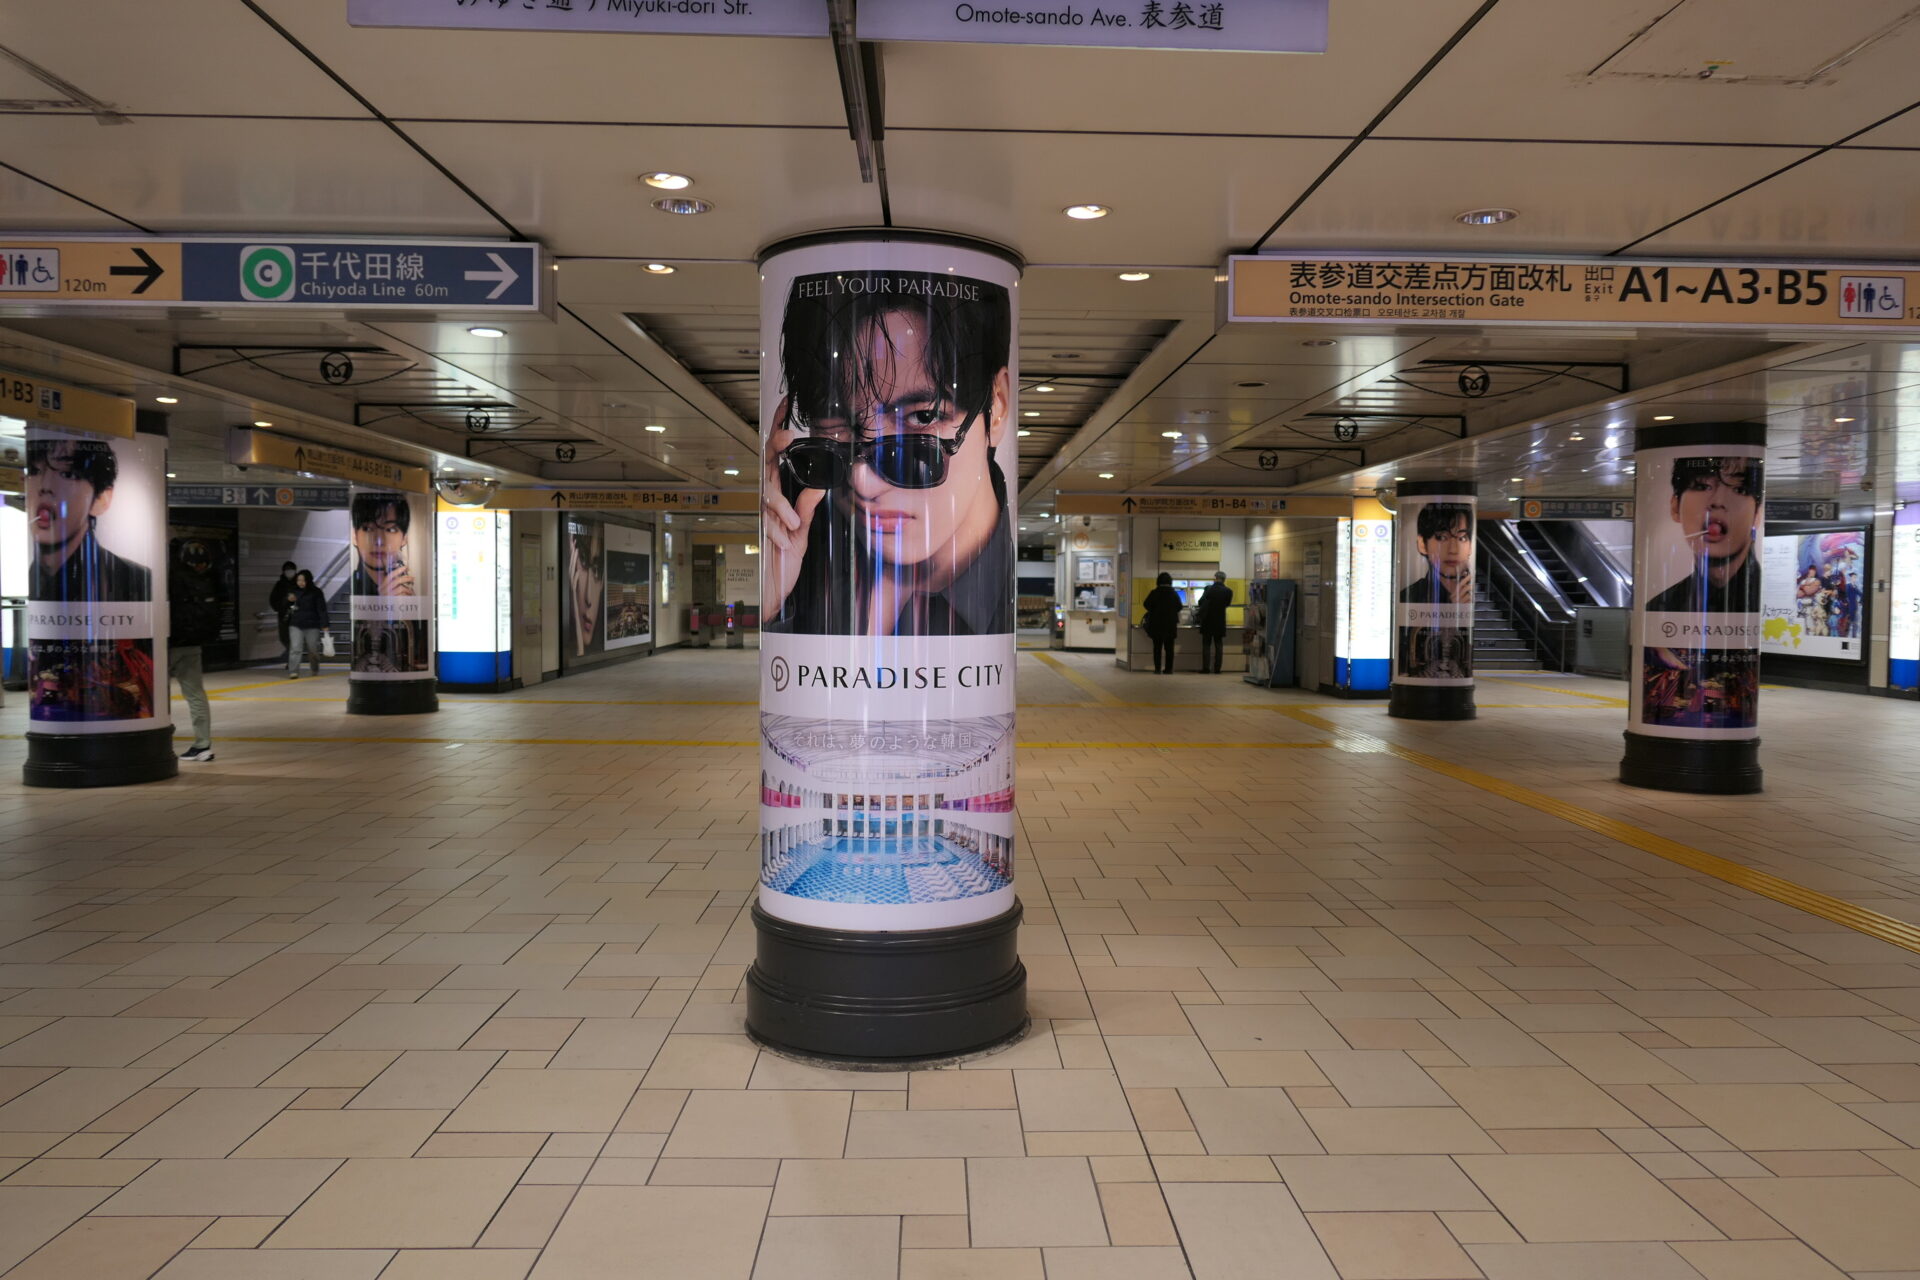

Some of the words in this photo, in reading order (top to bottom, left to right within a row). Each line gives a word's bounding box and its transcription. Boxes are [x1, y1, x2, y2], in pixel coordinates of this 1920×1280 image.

[723, 0, 753, 15] Str.
[955, 3, 1084, 26] Omote-sando
[1090, 7, 1132, 27] Ave.
[1139, 0, 1225, 30] 表参道
[258, 263, 273, 283] C
[301, 251, 425, 281] 千代田線
[1584, 265, 1614, 281] 出口
[64, 278, 107, 292] 120m
[1289, 261, 1573, 293] 表参道交差点方面改札
[300, 281, 367, 299] Chiyoda
[373, 283, 406, 297] Line
[414, 284, 449, 298] 60m
[798, 280, 833, 299] FEEL
[836, 277, 892, 295] YOUR
[898, 278, 980, 302] PARADISE
[1584, 283, 1614, 294] Exit
[1289, 291, 1392, 306] Omote-sando
[1396, 292, 1486, 307] Intersection
[1489, 294, 1525, 307] Gate
[225, 489, 235, 503] 3
[1615, 503, 1625, 517] 5
[1814, 503, 1824, 518] 6
[99, 615, 135, 626] CITY
[1682, 624, 1751, 636] PARADISE
[797, 664, 947, 690] PARADISE
[957, 663, 1003, 688] CITY
[793, 731, 978, 750] それは、夢のような韓国。
